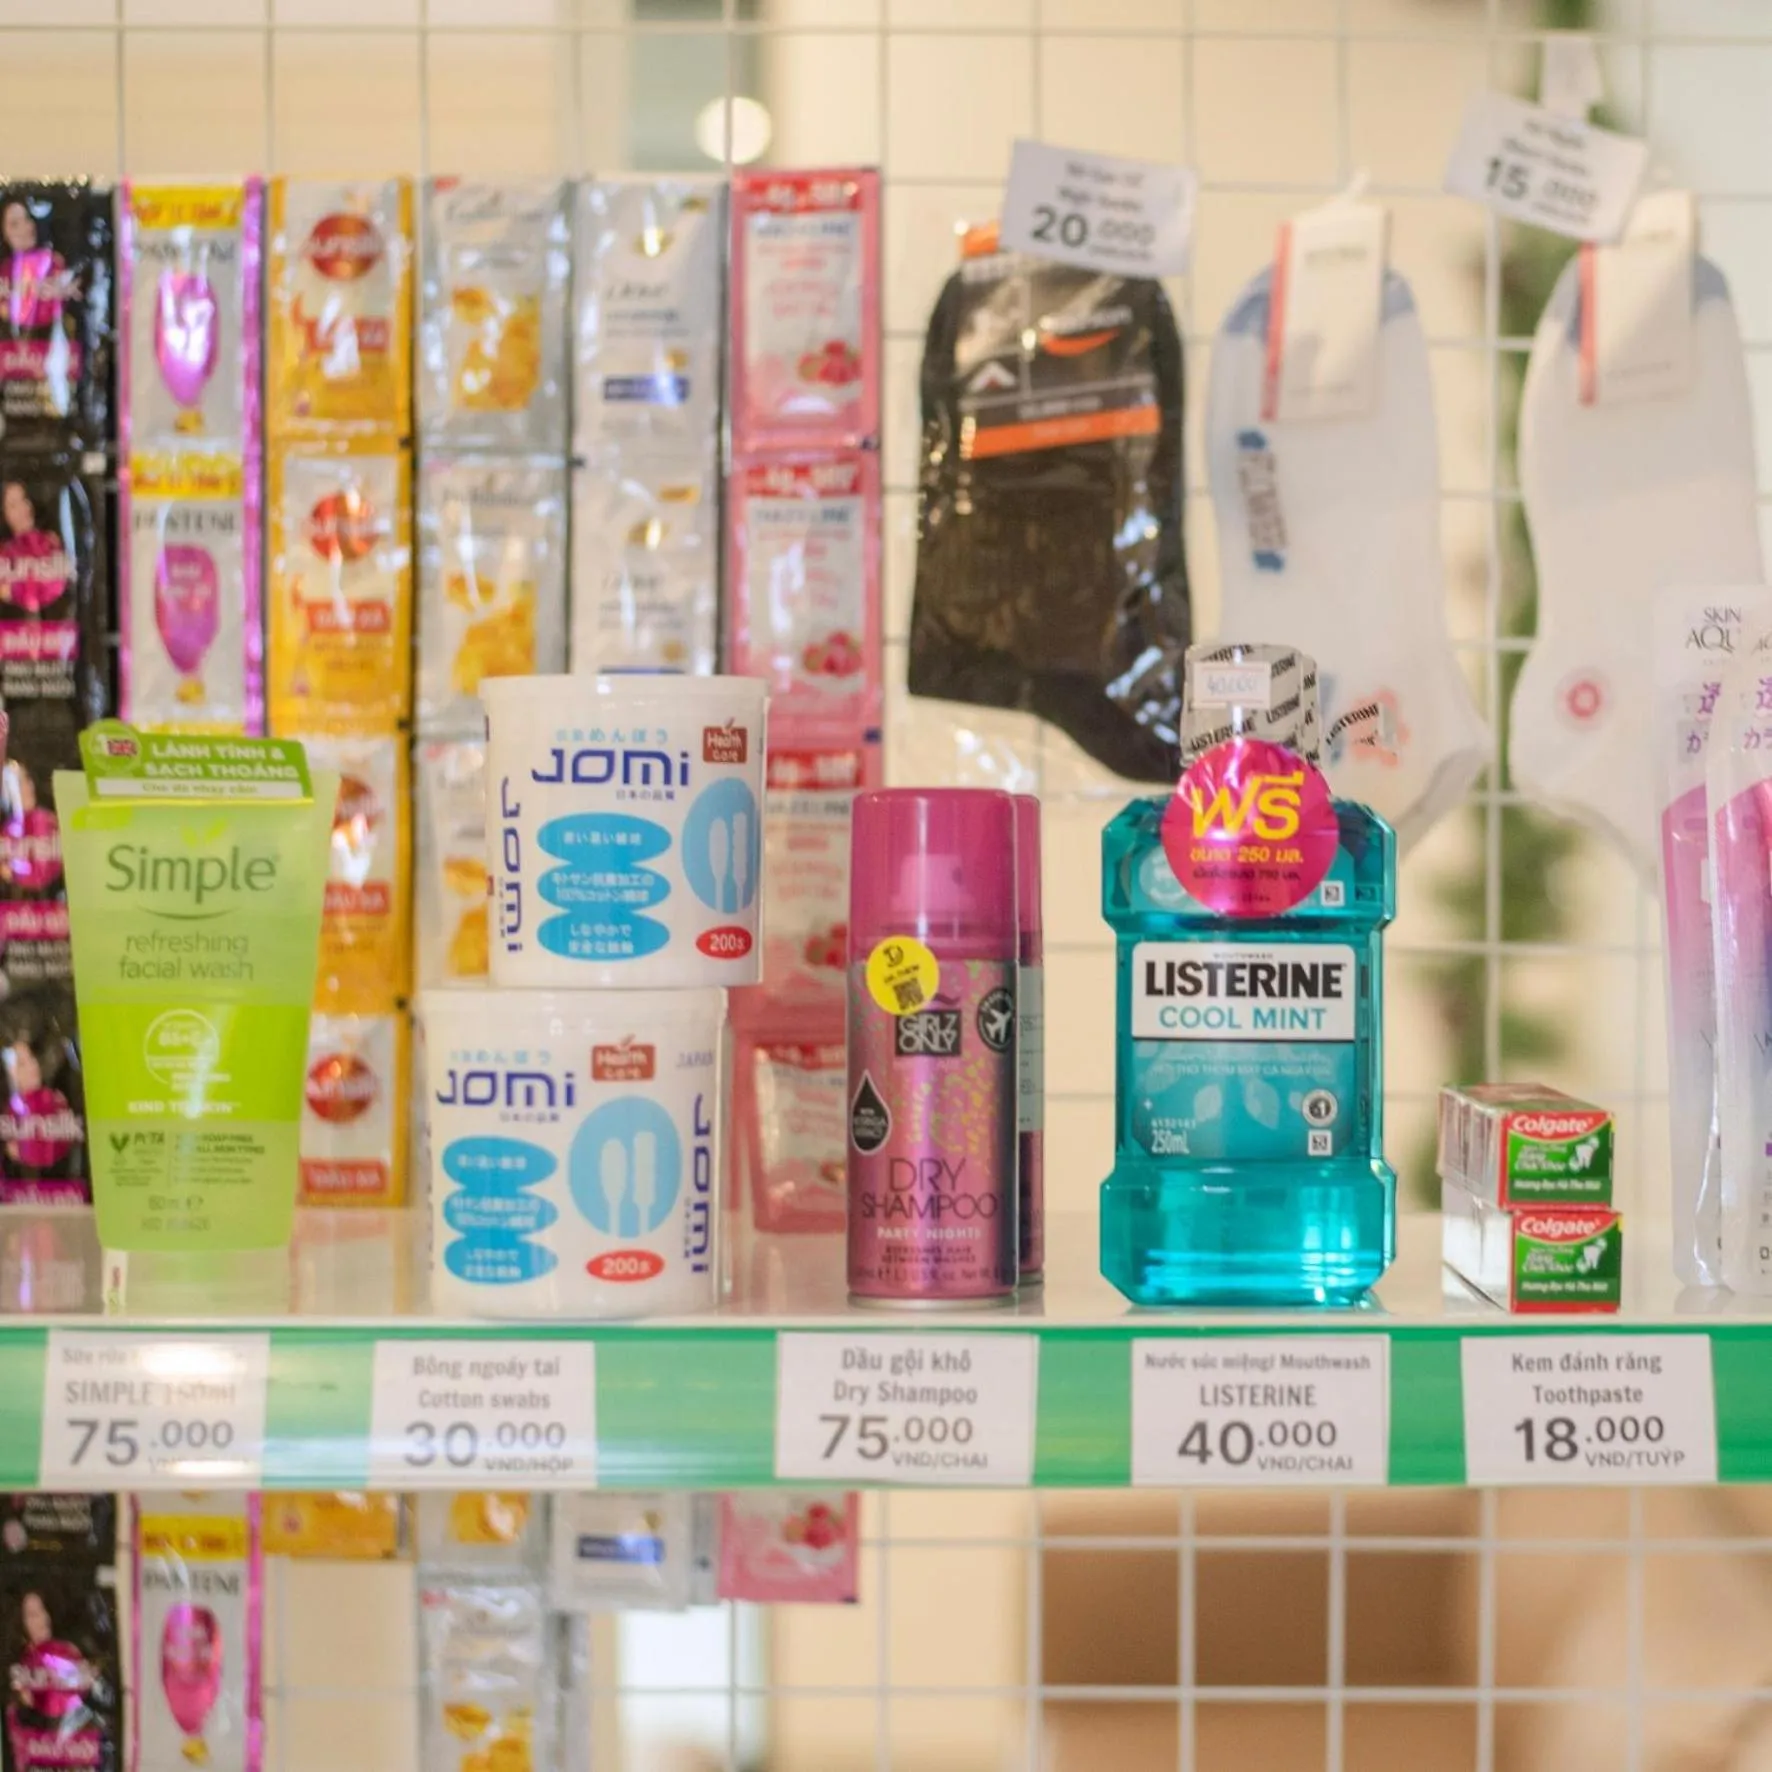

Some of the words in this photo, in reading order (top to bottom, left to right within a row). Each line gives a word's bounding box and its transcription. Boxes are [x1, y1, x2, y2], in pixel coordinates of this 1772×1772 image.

[105, 844, 278, 906] Simple
[125, 932, 250, 955] refreshing
[120, 956, 181, 980] facial
[189, 957, 255, 980] wash
[1144, 960, 1344, 998] LISTERINE
[1159, 1005, 1242, 1030] COOL
[1253, 1007, 1327, 1030] MINT
[1513, 1115, 1589, 1137] Colgate
[890, 1157, 967, 1193] DRY
[862, 1191, 999, 1219] SHAMPOO
[1521, 1216, 1596, 1238] Colgate
[413, 1355, 462, 1380] Bông
[534, 1356, 561, 1377] tai
[841, 1346, 883, 1371] Dầu
[889, 1350, 924, 1377] gội
[1279, 1353, 1372, 1371] Mouthwash
[1511, 1354, 1553, 1373] Kem
[1559, 1352, 1610, 1373] đánh
[1616, 1353, 1663, 1375] răng
[65, 1379, 152, 1405] SIMPLE
[418, 1389, 484, 1409] Cotton
[490, 1389, 552, 1410] swabs
[833, 1380, 869, 1406] Dry
[877, 1380, 979, 1407] Shampoo
[1199, 1383, 1318, 1408] LISTERINE
[1533, 1385, 1644, 1407] Toothpaste
[891, 1451, 989, 1470] VND/CHAI
[1257, 1455, 1353, 1472] VND/CHAI
